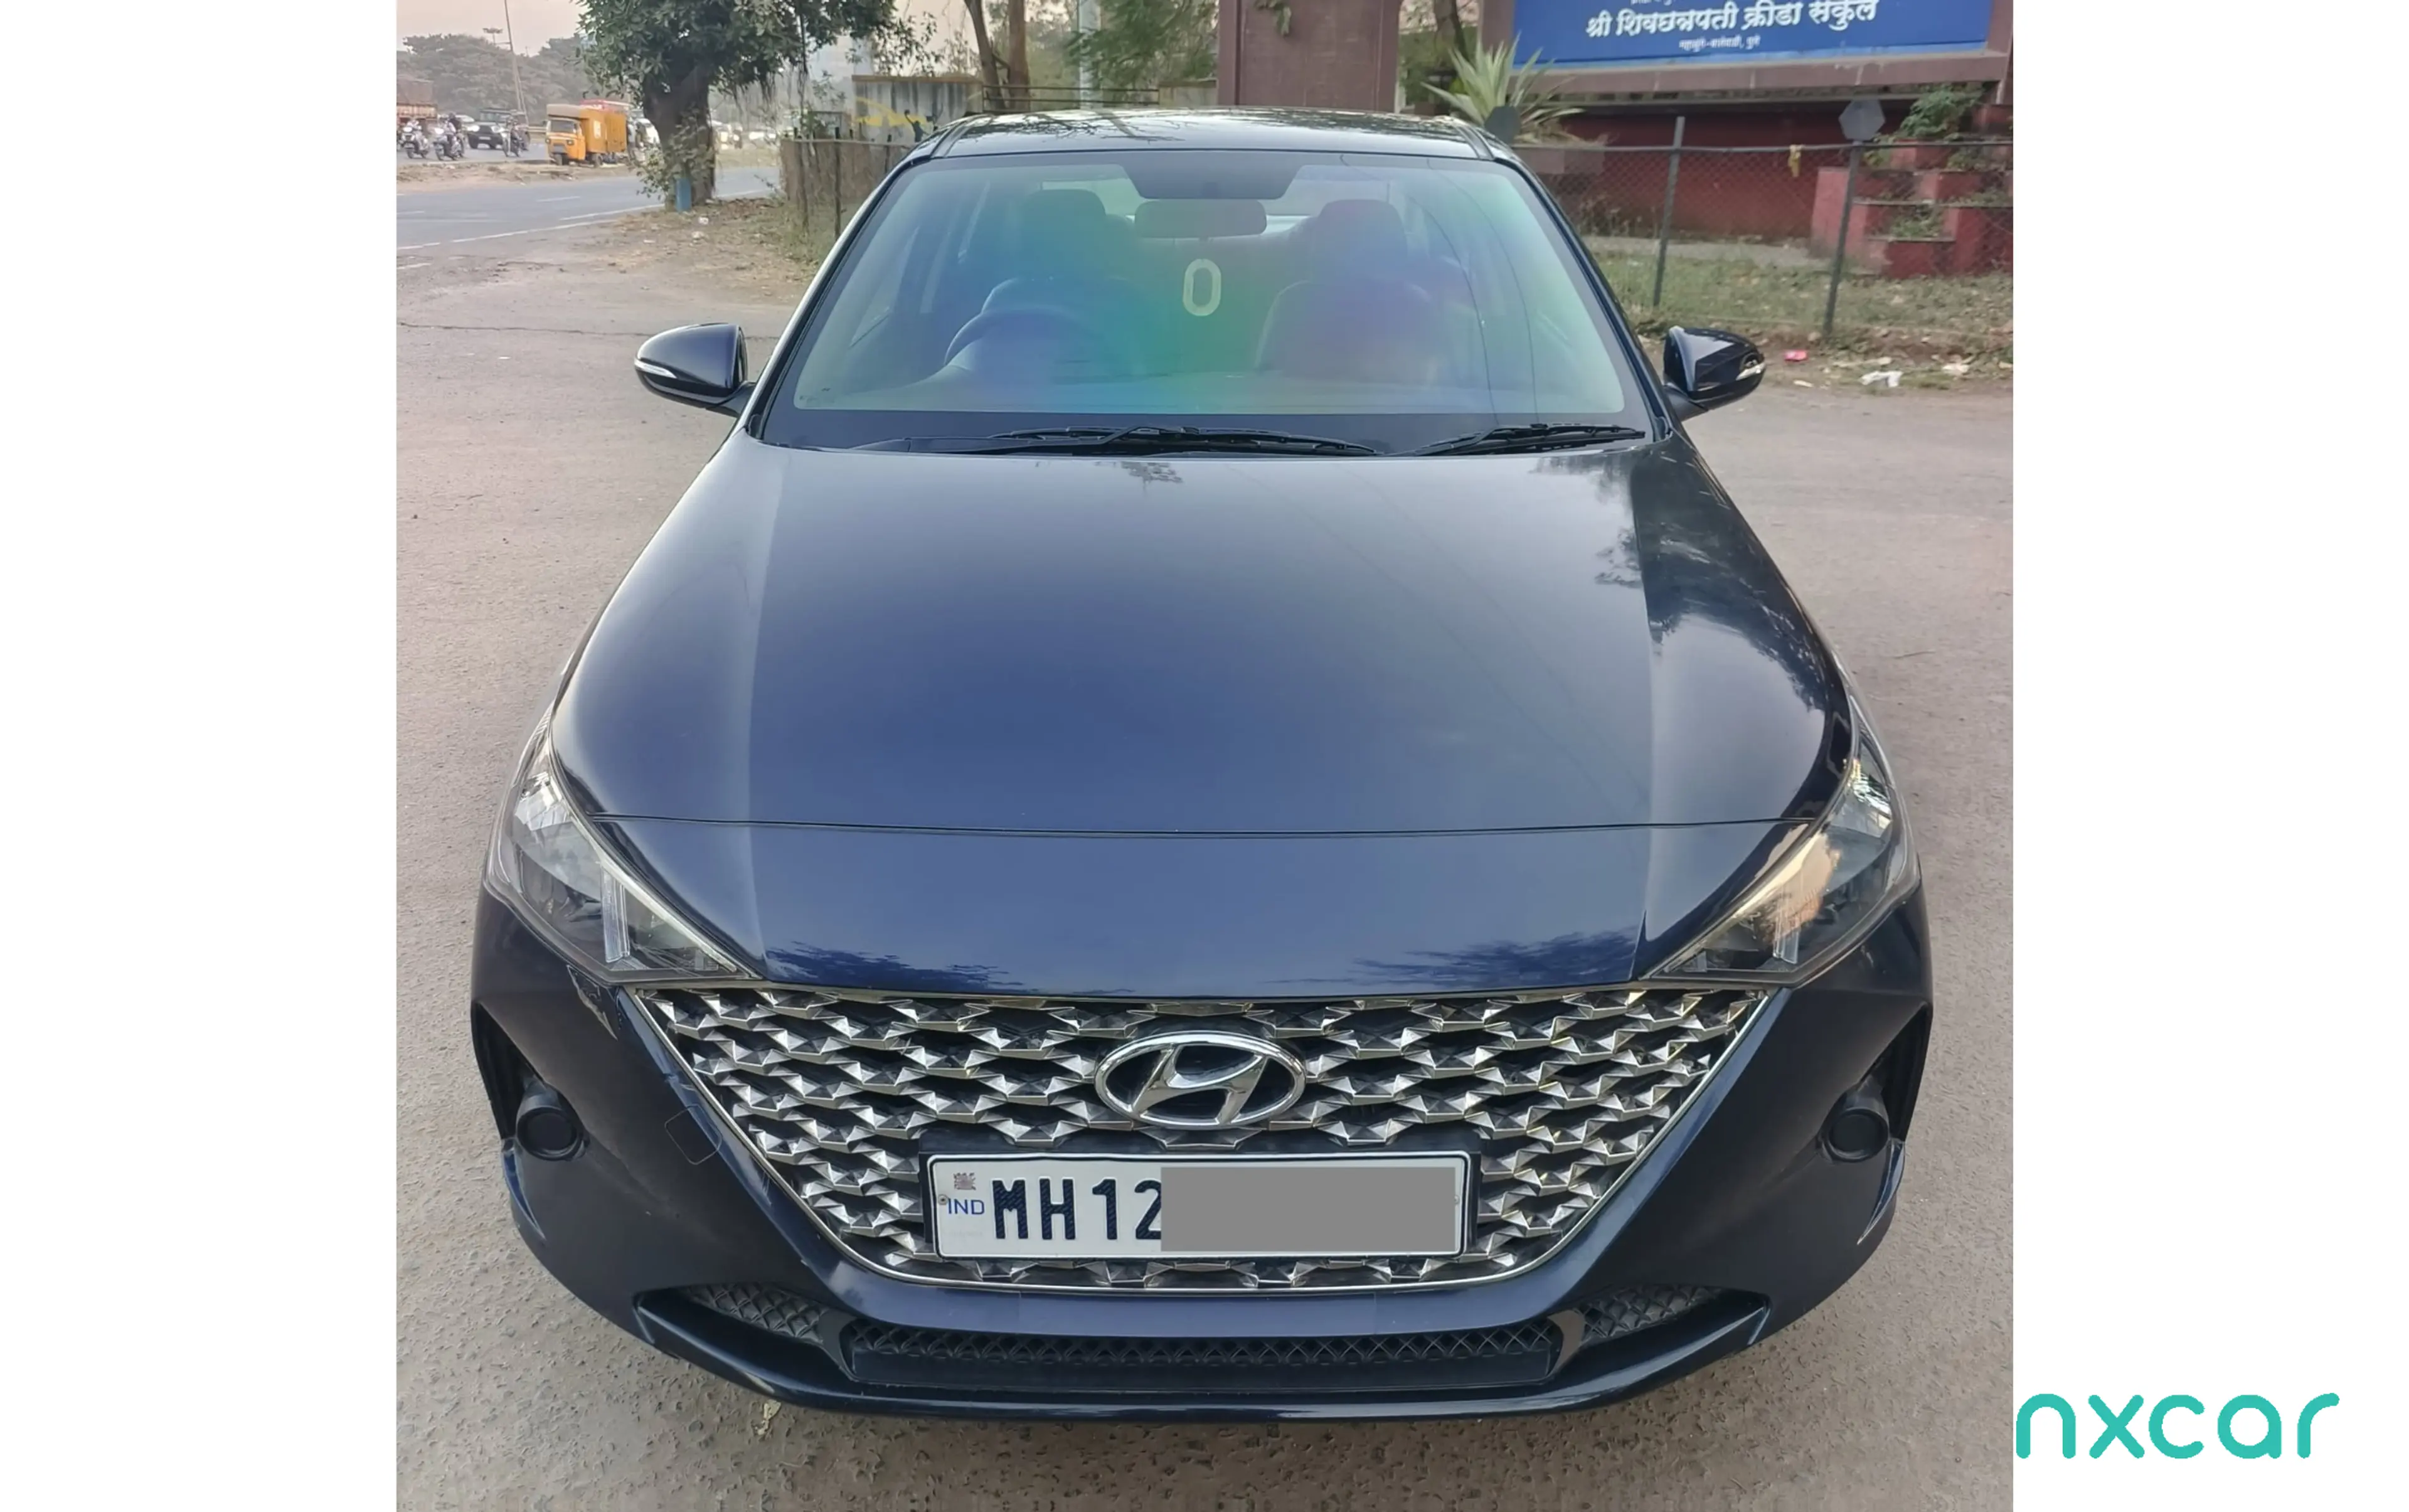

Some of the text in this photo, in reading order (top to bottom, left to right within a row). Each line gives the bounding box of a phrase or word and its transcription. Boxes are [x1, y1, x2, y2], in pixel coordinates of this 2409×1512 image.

[1586, 10, 1613, 37] श्री
[1741, 0, 1804, 30] क्रीडा
[1809, 0, 1880, 31] सकुल
[947, 1198, 985, 1215] IND
